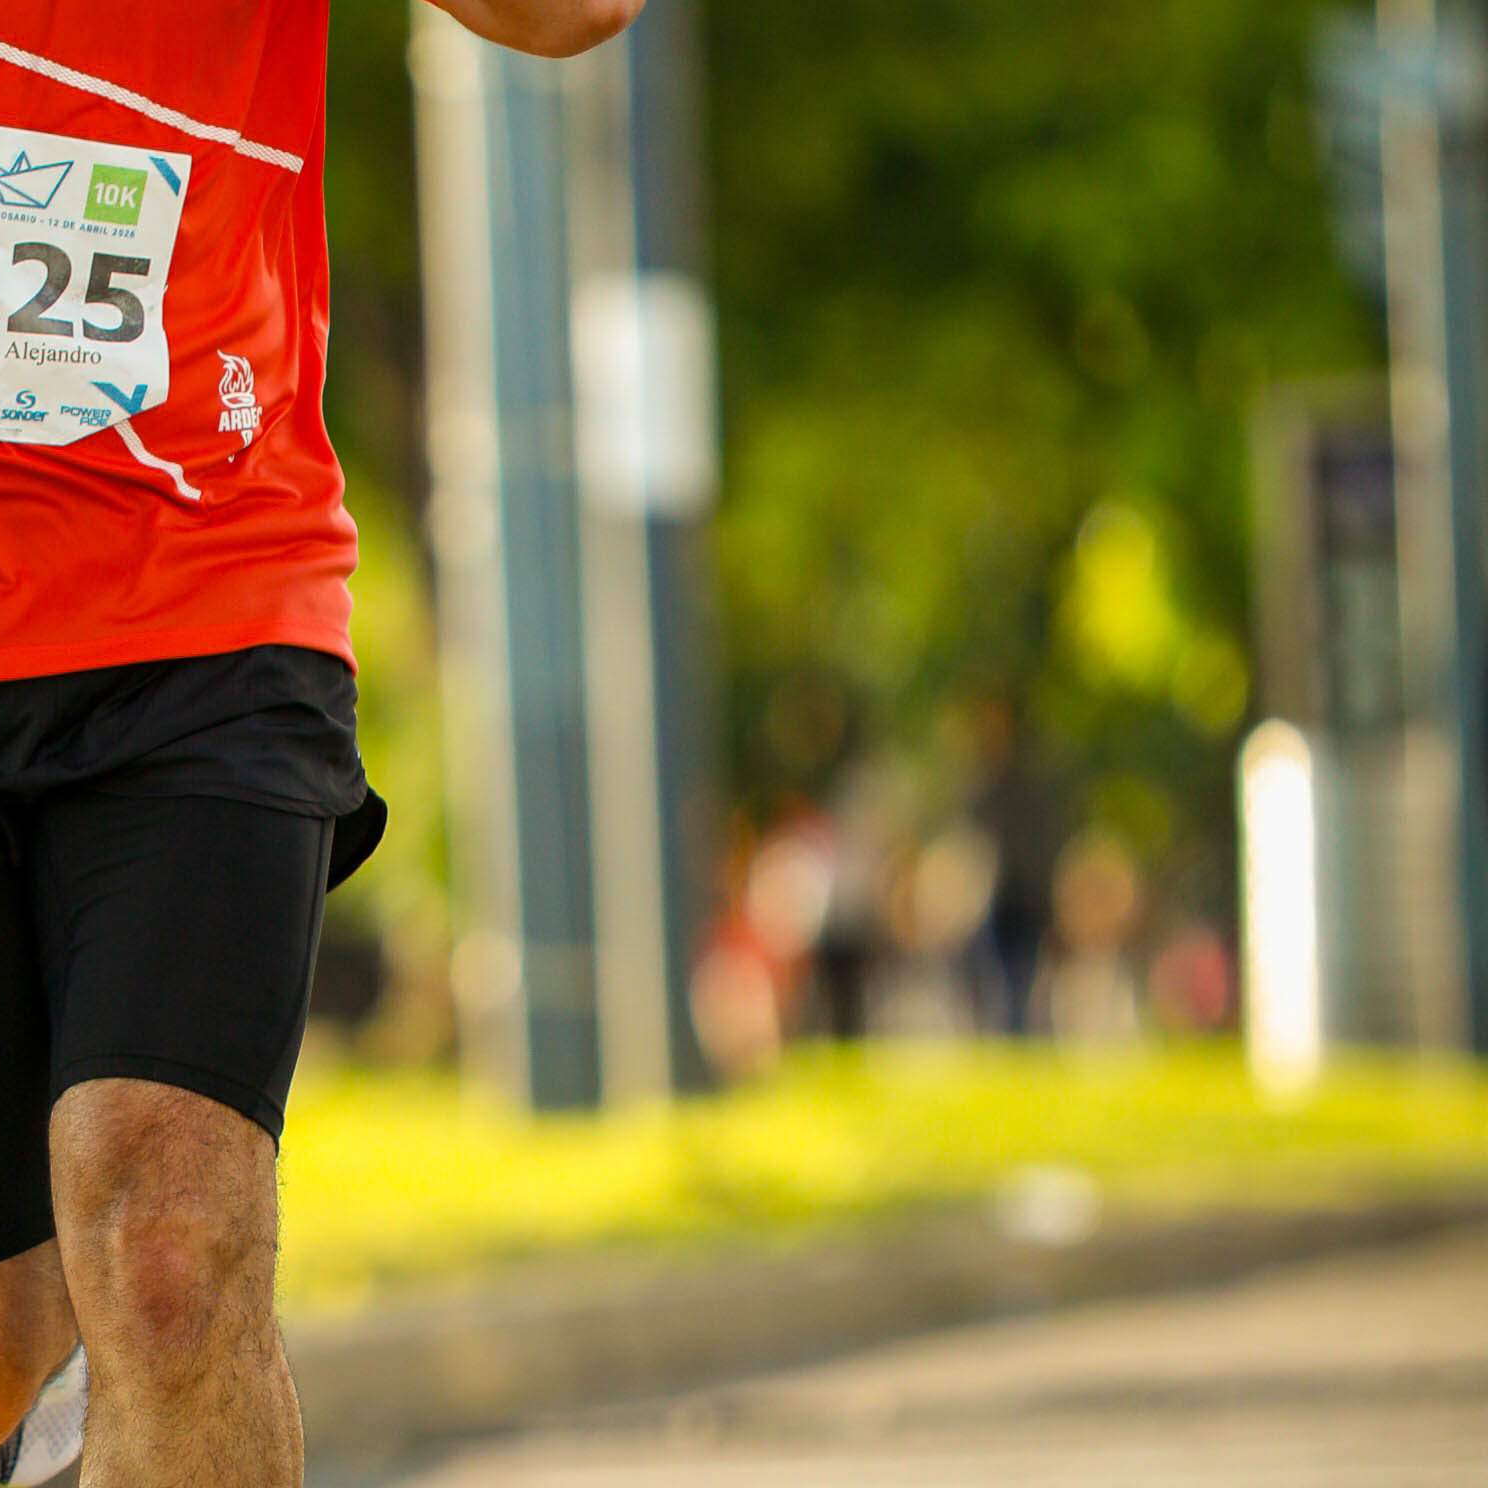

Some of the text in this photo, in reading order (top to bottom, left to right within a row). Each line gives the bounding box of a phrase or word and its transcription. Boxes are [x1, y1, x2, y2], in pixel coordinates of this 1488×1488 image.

[93, 181, 138, 209] 10K
[48, 218, 59, 227] 12
[63, 220, 75, 229] DE
[79, 223, 108, 235] ABRIL
[112, 228, 136, 239] 2026
[5, 341, 102, 366] Alejandro
[60, 405, 112, 417] POWER
